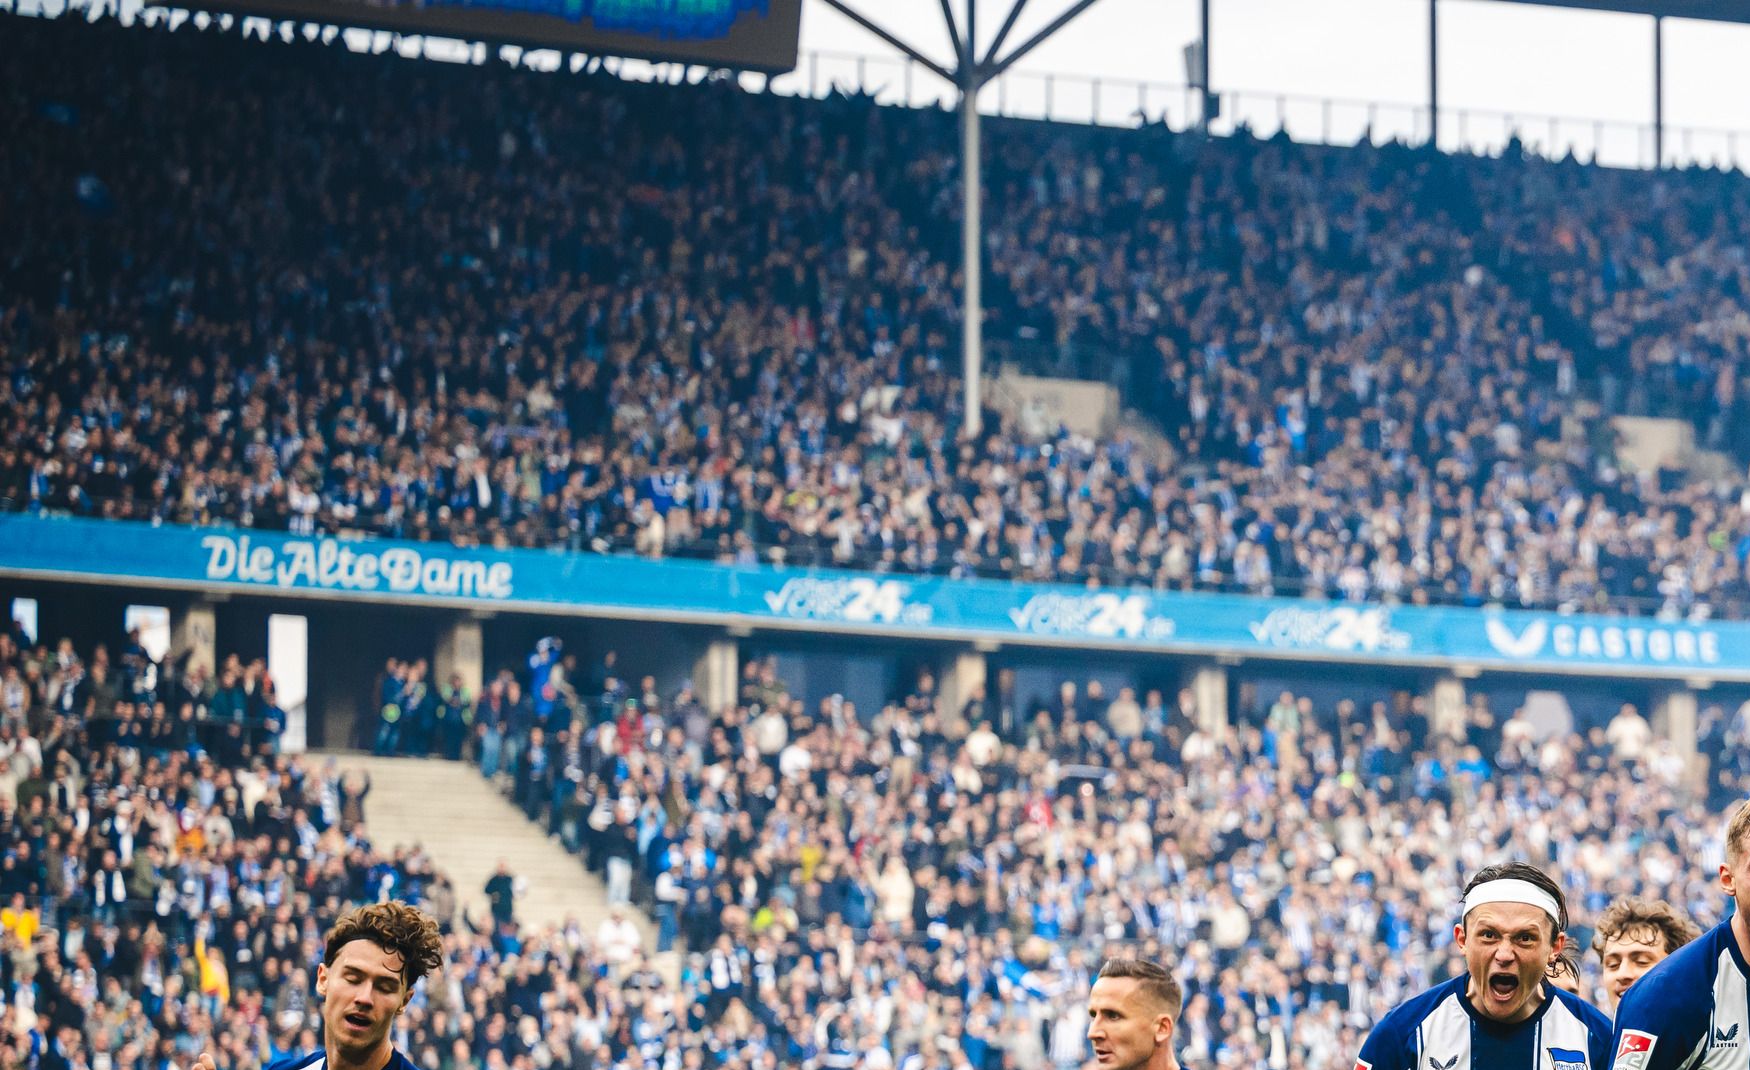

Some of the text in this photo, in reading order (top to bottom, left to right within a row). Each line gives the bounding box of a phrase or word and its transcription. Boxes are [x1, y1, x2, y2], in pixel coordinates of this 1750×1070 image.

[202, 534, 514, 598] Die Alte Dame
[1552, 623, 1720, 664] CASTORE
